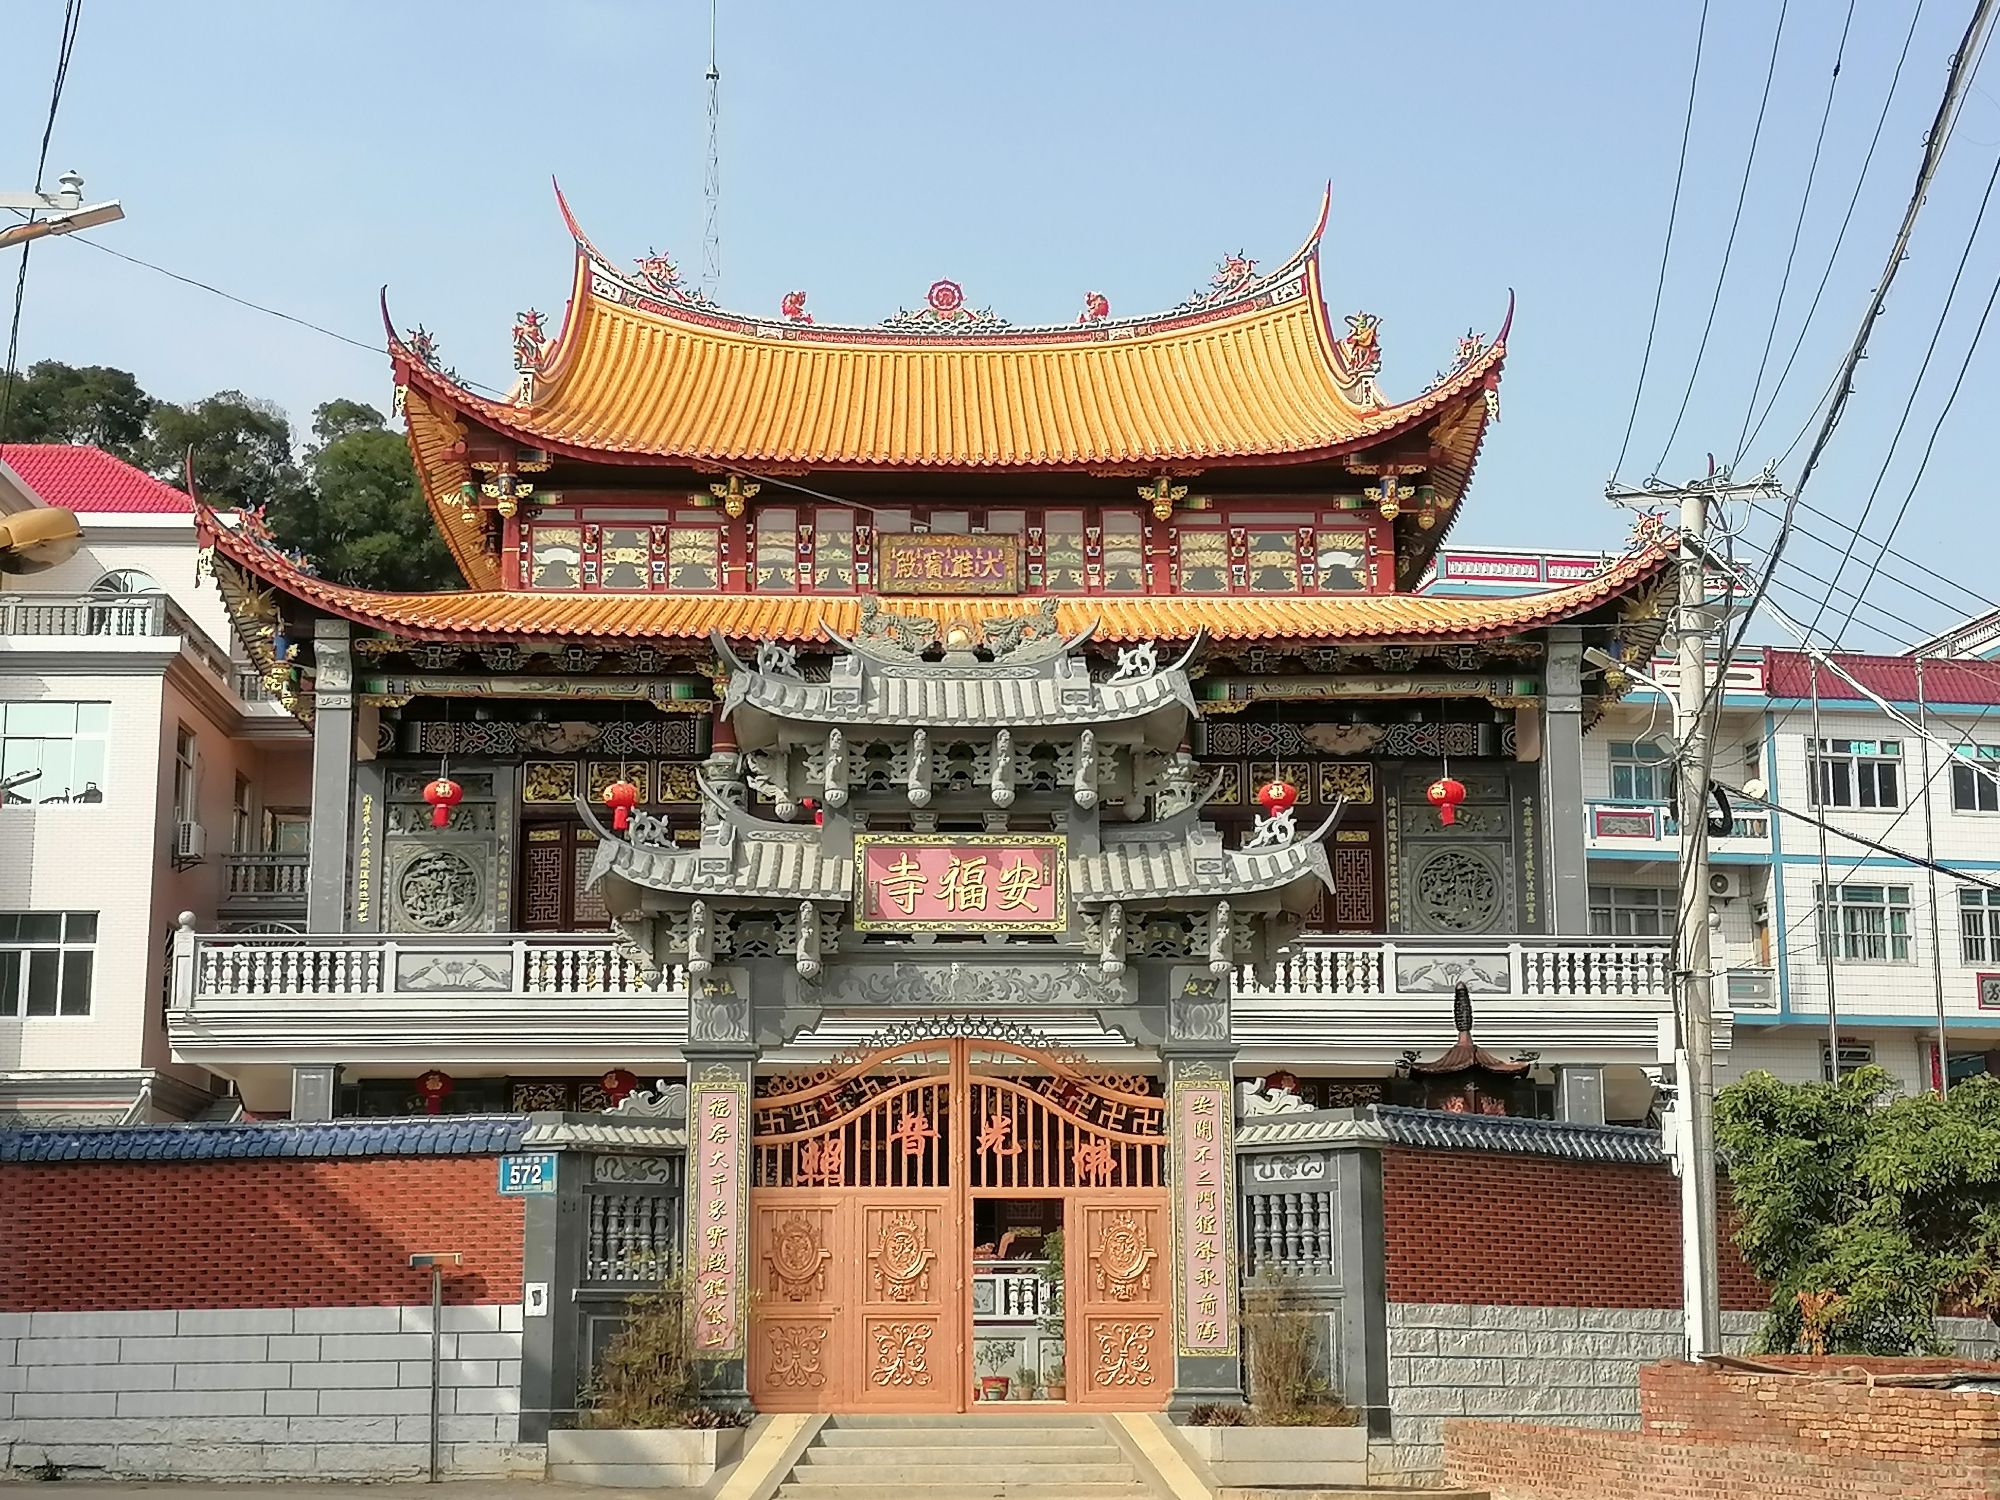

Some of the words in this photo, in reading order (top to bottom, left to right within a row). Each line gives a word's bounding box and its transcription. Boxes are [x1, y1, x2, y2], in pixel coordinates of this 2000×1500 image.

[880, 852, 1042, 914] 安福寺
[510, 1164, 542, 1184] 572
